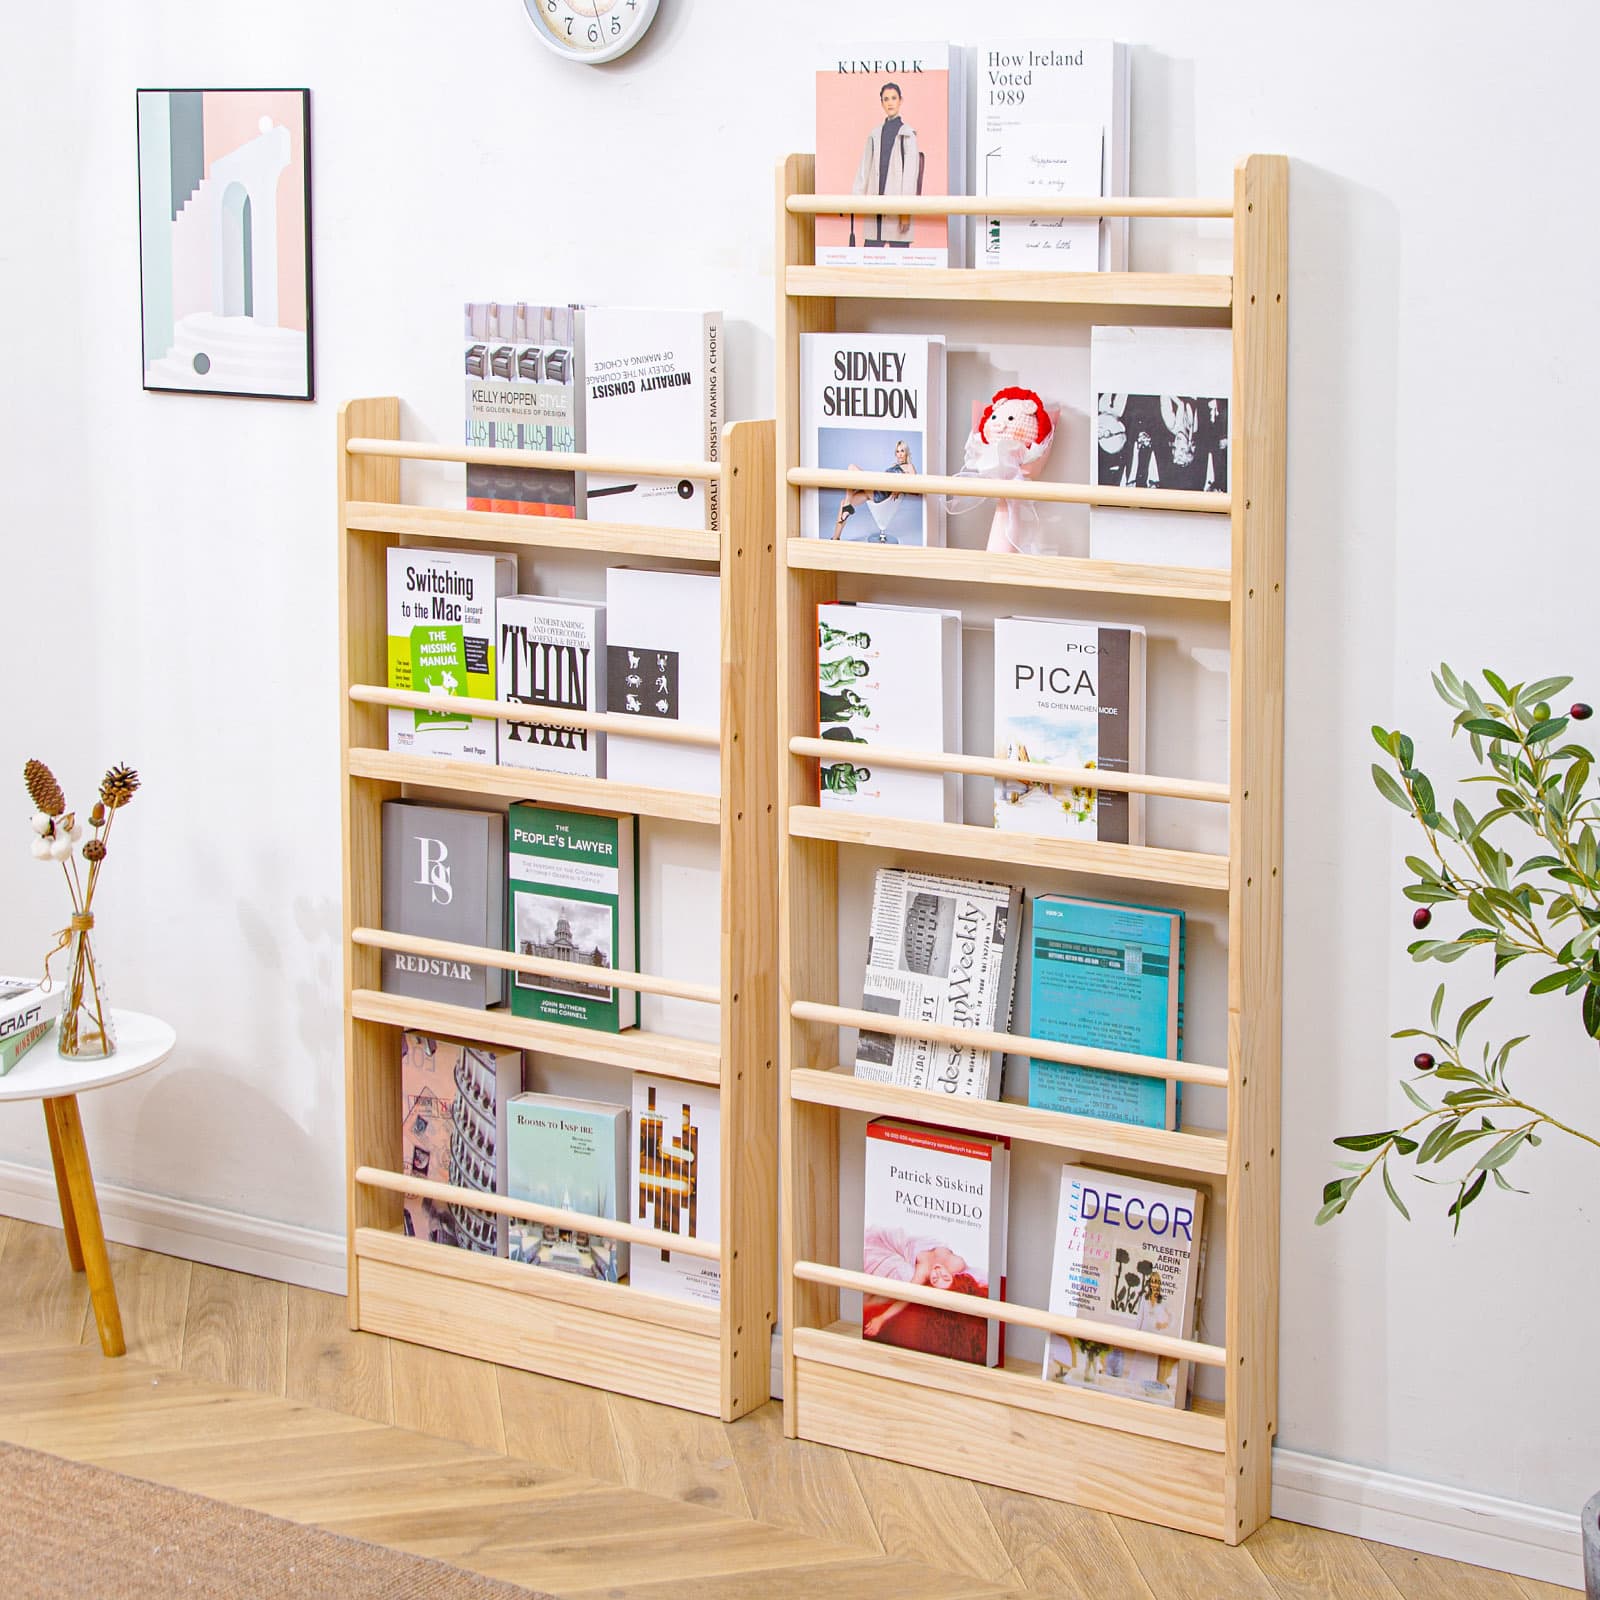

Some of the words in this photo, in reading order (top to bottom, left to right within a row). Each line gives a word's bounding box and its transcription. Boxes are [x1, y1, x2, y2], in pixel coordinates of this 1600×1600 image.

[564, 17, 574, 35] 7
[587, 23, 598, 42] 6
[610, 15, 621, 35] 5
[988, 51, 1024, 67] How
[1029, 50, 1084, 67] Ireland
[837, 60, 924, 74] KINFOLK
[988, 70, 1032, 86] Voted
[989, 89, 1025, 106] 1989
[709, 325, 717, 364] CHOICE
[630, 354, 662, 366] MAKING
[663, 351, 674, 361] OF
[594, 359, 623, 372] CHOICE
[648, 363, 676, 375] SOLELY
[709, 366, 717, 374] A
[834, 350, 906, 382] SIDNEY
[623, 371, 638, 379] THE
[640, 372, 692, 392] MORALITY
[592, 380, 636, 399] CONSIST
[709, 375, 717, 418] MAKING
[472, 390, 499, 404] KELLY
[500, 392, 537, 406] HOPPEN
[823, 385, 918, 419] SHELDON
[486, 406, 511, 414] GOLDEN
[406, 566, 474, 601] Switching
[401, 601, 411, 618] to
[414, 602, 429, 619] the
[432, 596, 462, 622] Mac
[428, 631, 447, 641] THE
[420, 642, 457, 654] MISSING
[419, 654, 459, 667] MANUAL
[1015, 664, 1097, 697] PICA
[1037, 701, 1049, 709] TAS
[1050, 702, 1069, 711] CHEN
[1069, 704, 1098, 713] MACHEN
[1098, 706, 1118, 716] MODE
[555, 824, 570, 833] THE
[514, 828, 565, 848] PEOPLE'S
[568, 836, 613, 855] LAWYER
[395, 953, 472, 981] REDSTAR
[542, 1000, 558, 1008] JOHN
[559, 1009, 588, 1020] CONNELL
[890, 1166, 932, 1185] Patrick
[935, 1175, 984, 1196] Süskind
[1081, 1188, 1193, 1241] DECOR
[1157, 1254, 1181, 1266] AERIN
[1069, 1274, 1099, 1287] NATURAL
[1071, 1282, 1098, 1294] BEAUTY
